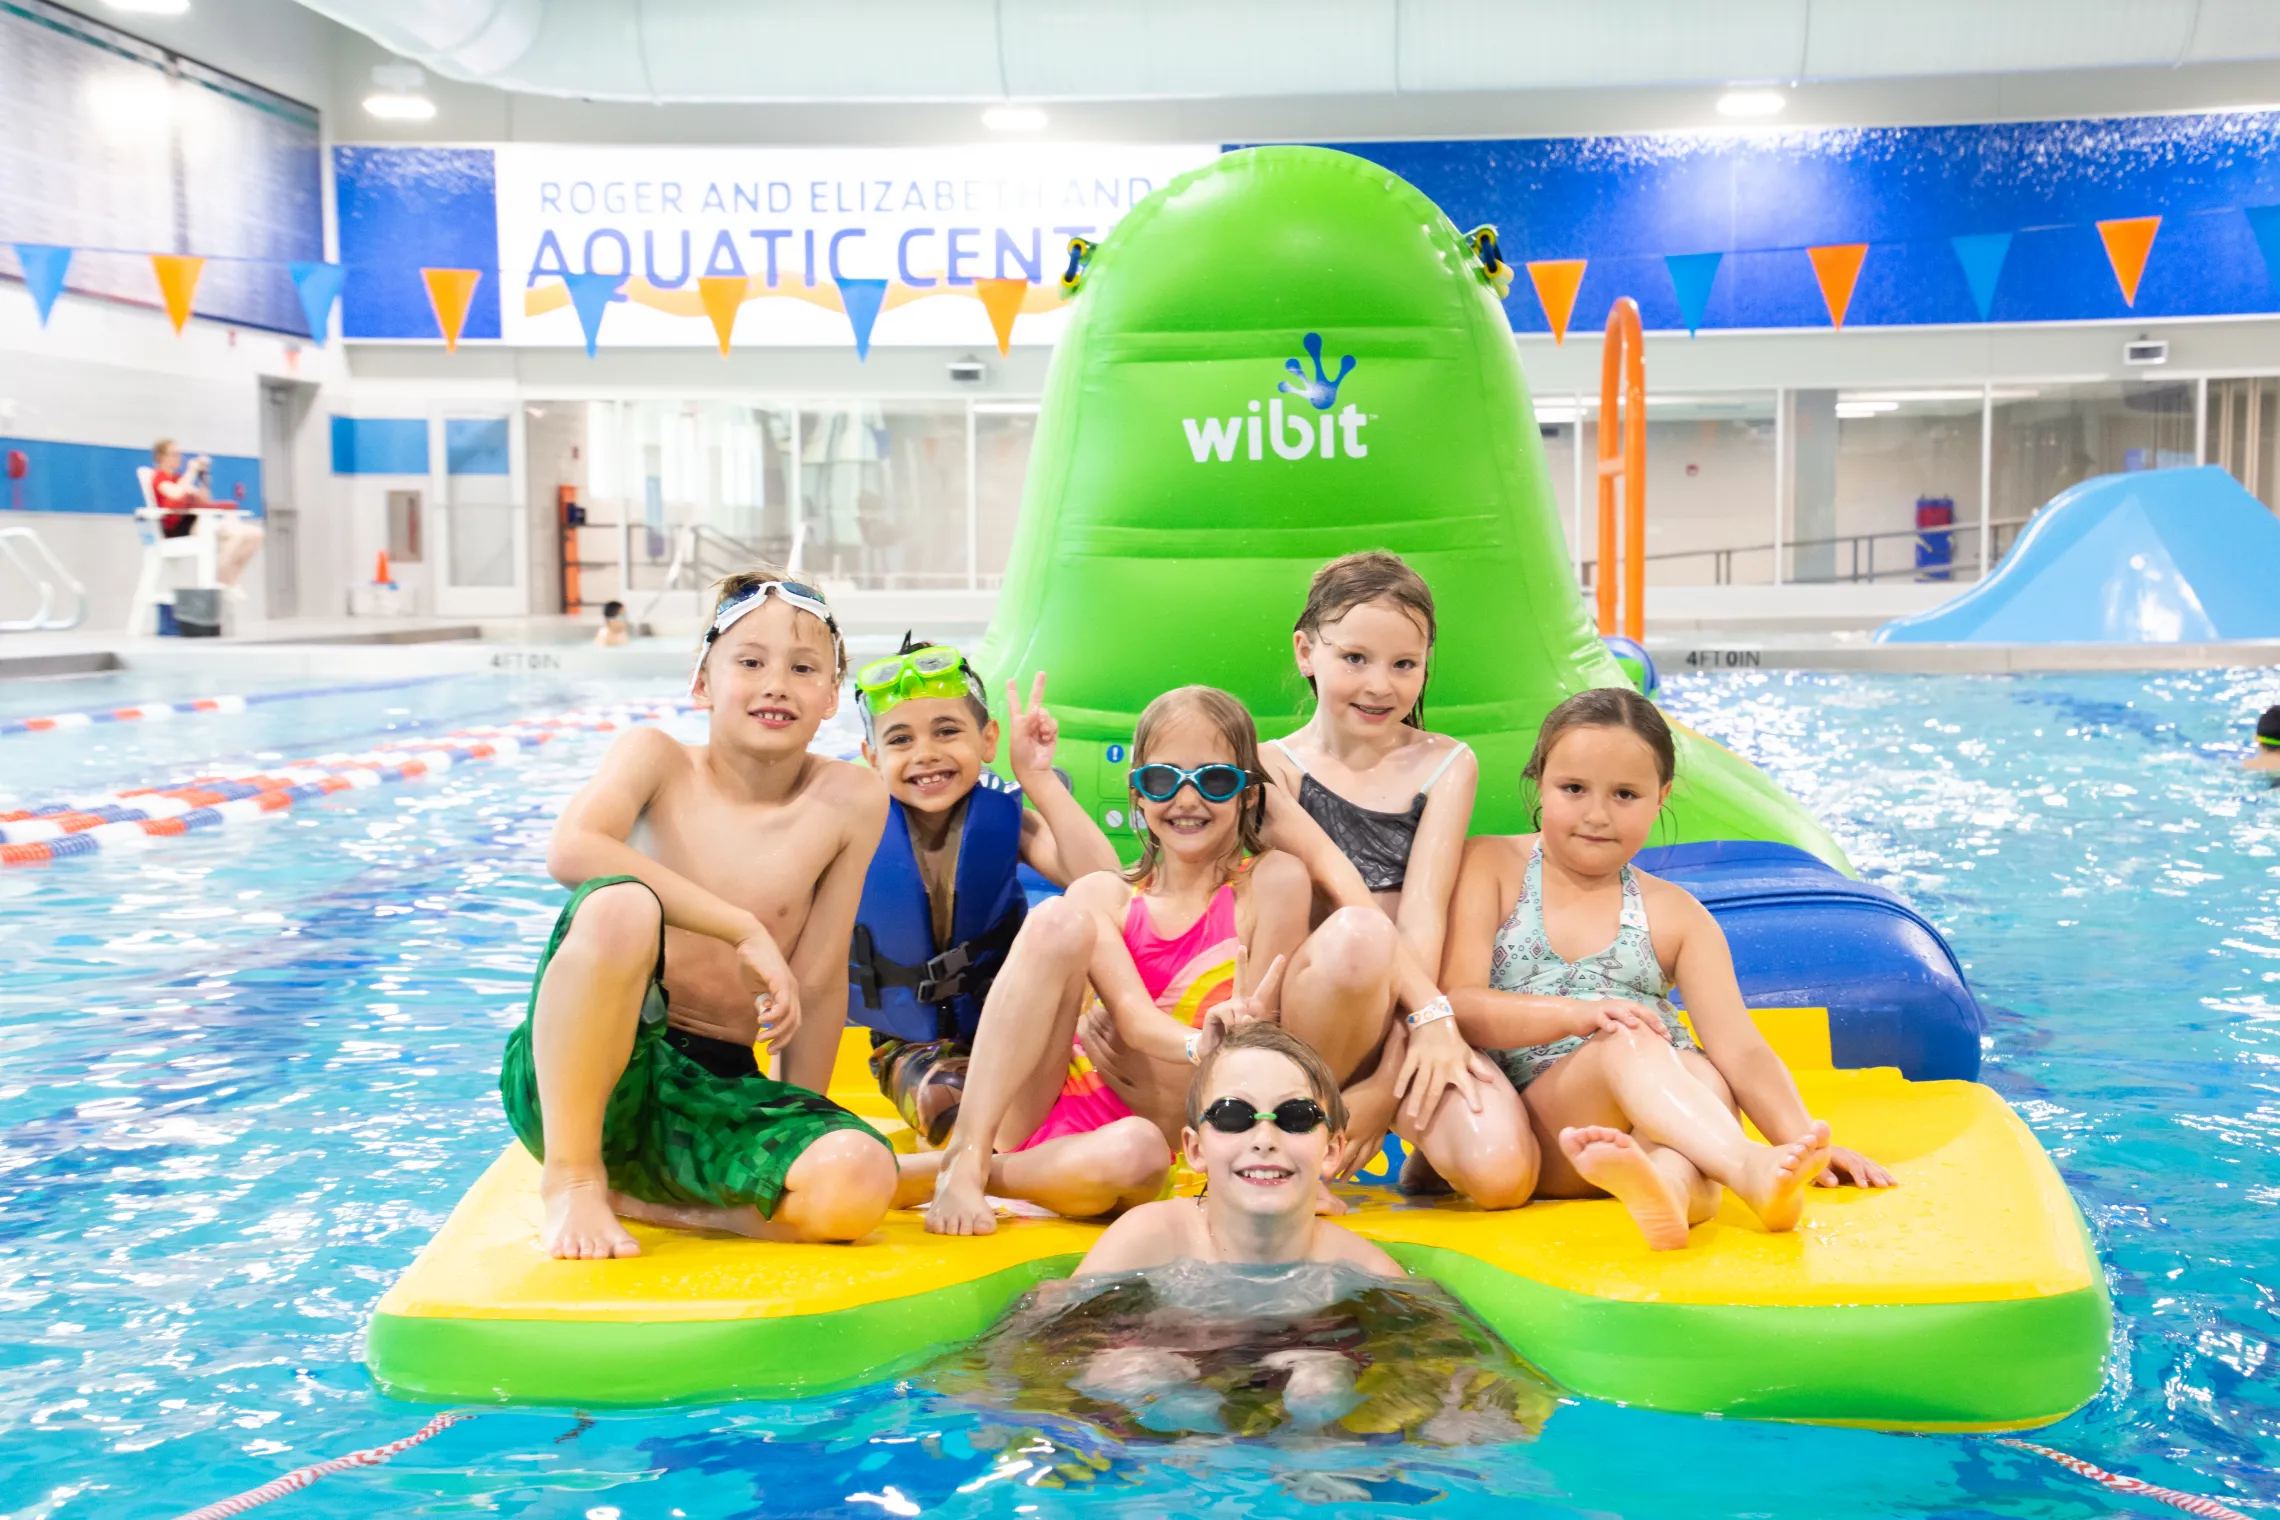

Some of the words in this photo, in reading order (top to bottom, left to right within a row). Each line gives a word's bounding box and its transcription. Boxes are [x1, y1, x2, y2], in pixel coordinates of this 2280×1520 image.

[541, 181, 683, 214] ROGER
[701, 181, 792, 213] AND
[810, 179, 1043, 213] ELIZABETH
[1062, 177, 1153, 210] AND
[527, 227, 867, 302] AQUATIC
[1685, 650, 1720, 668] 4FT
